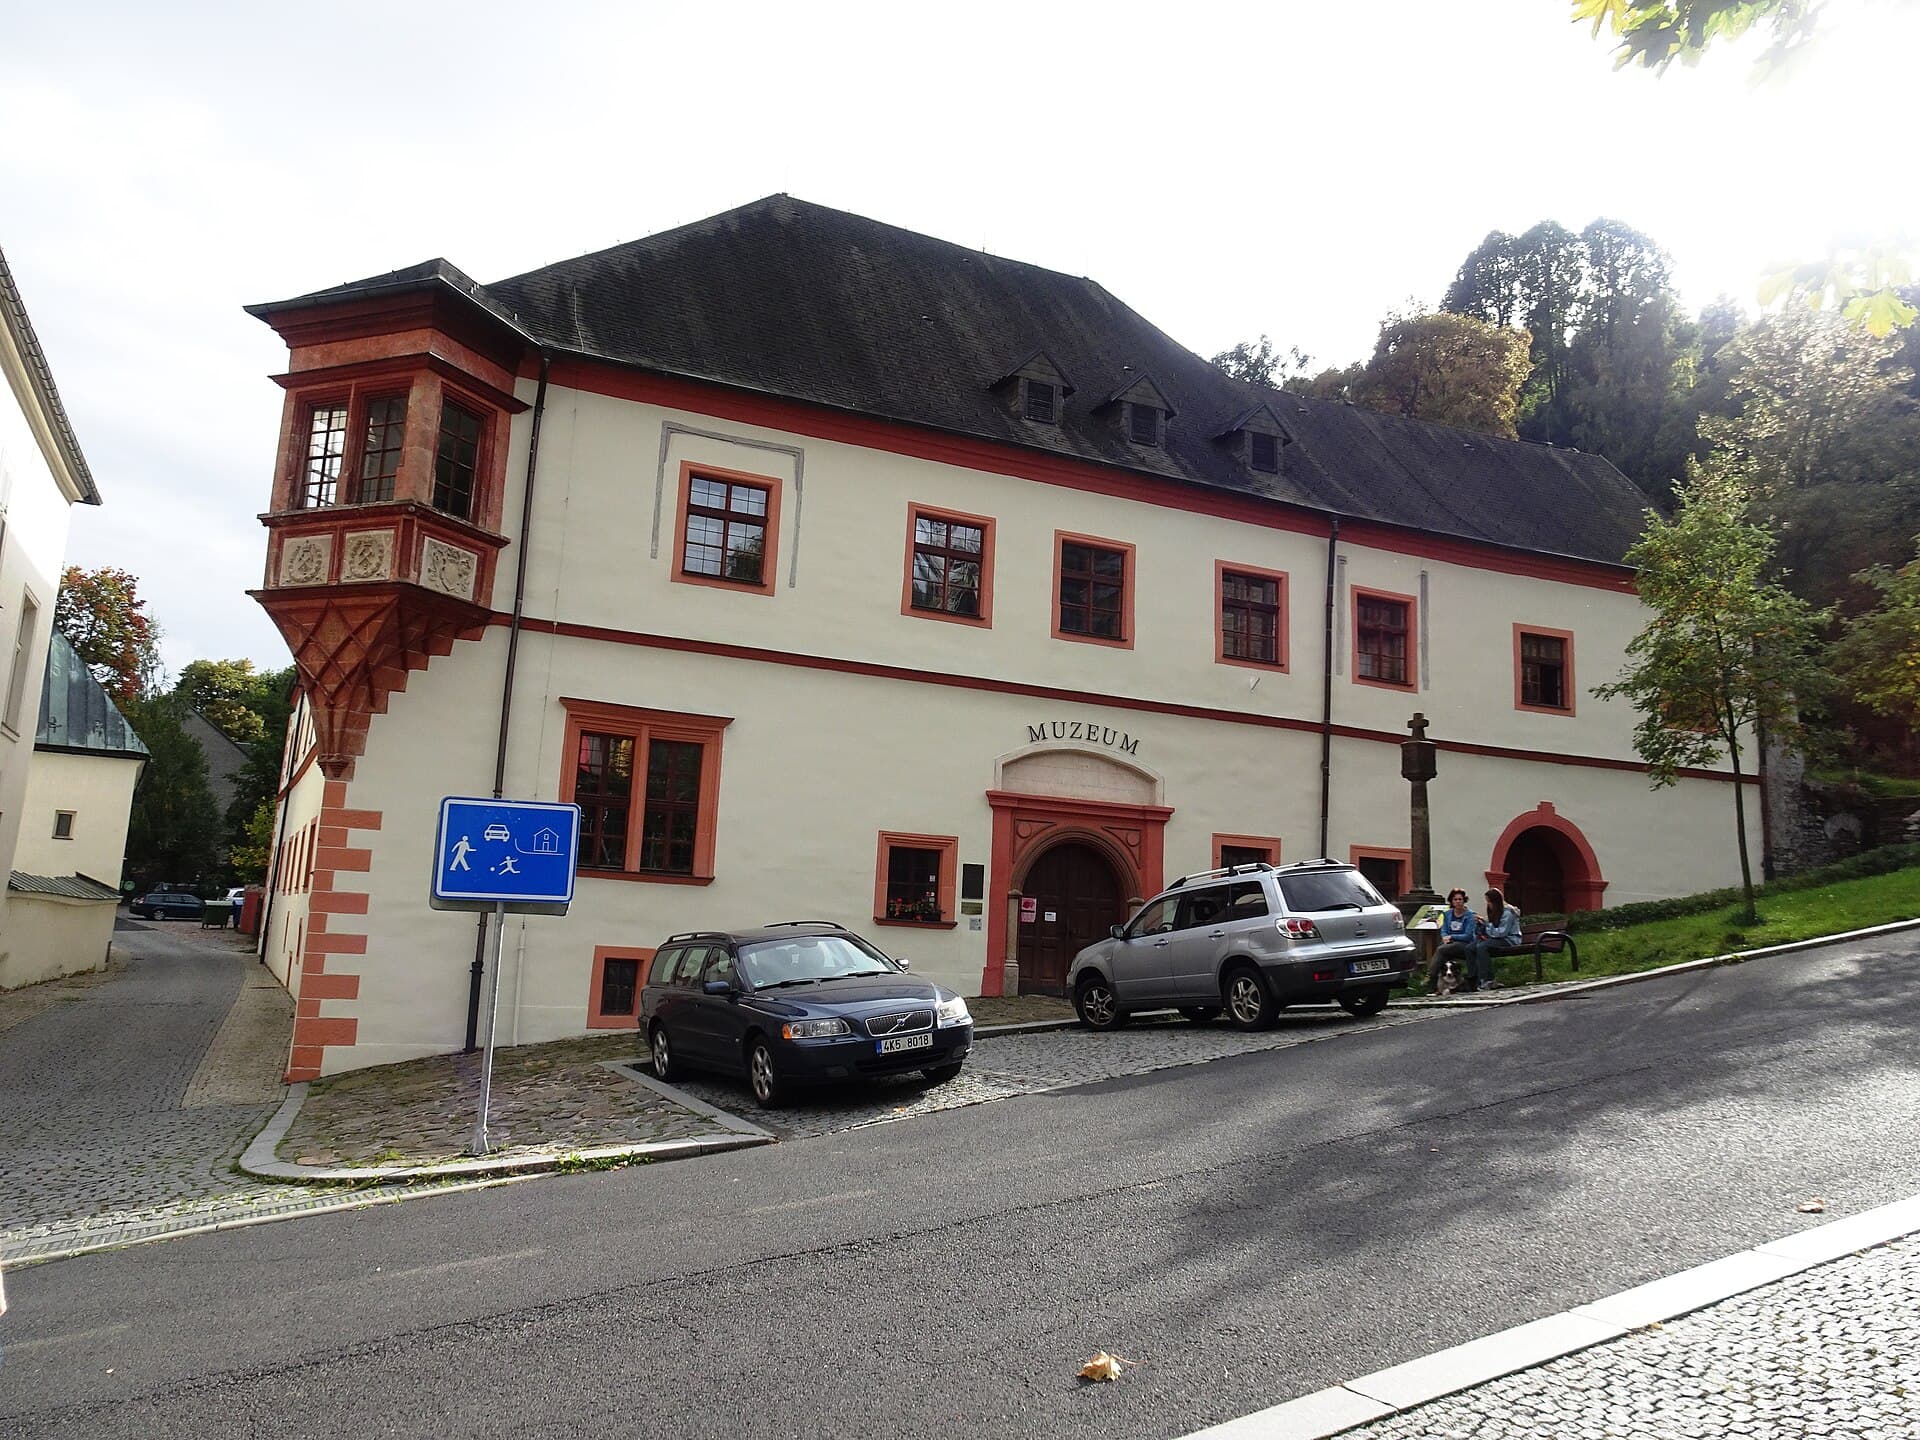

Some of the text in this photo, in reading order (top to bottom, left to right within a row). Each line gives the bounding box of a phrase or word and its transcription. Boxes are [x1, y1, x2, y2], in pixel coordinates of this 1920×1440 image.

[1027, 721, 1139, 755] MUZEUM
[884, 1034, 929, 1051] 4K5 8018
